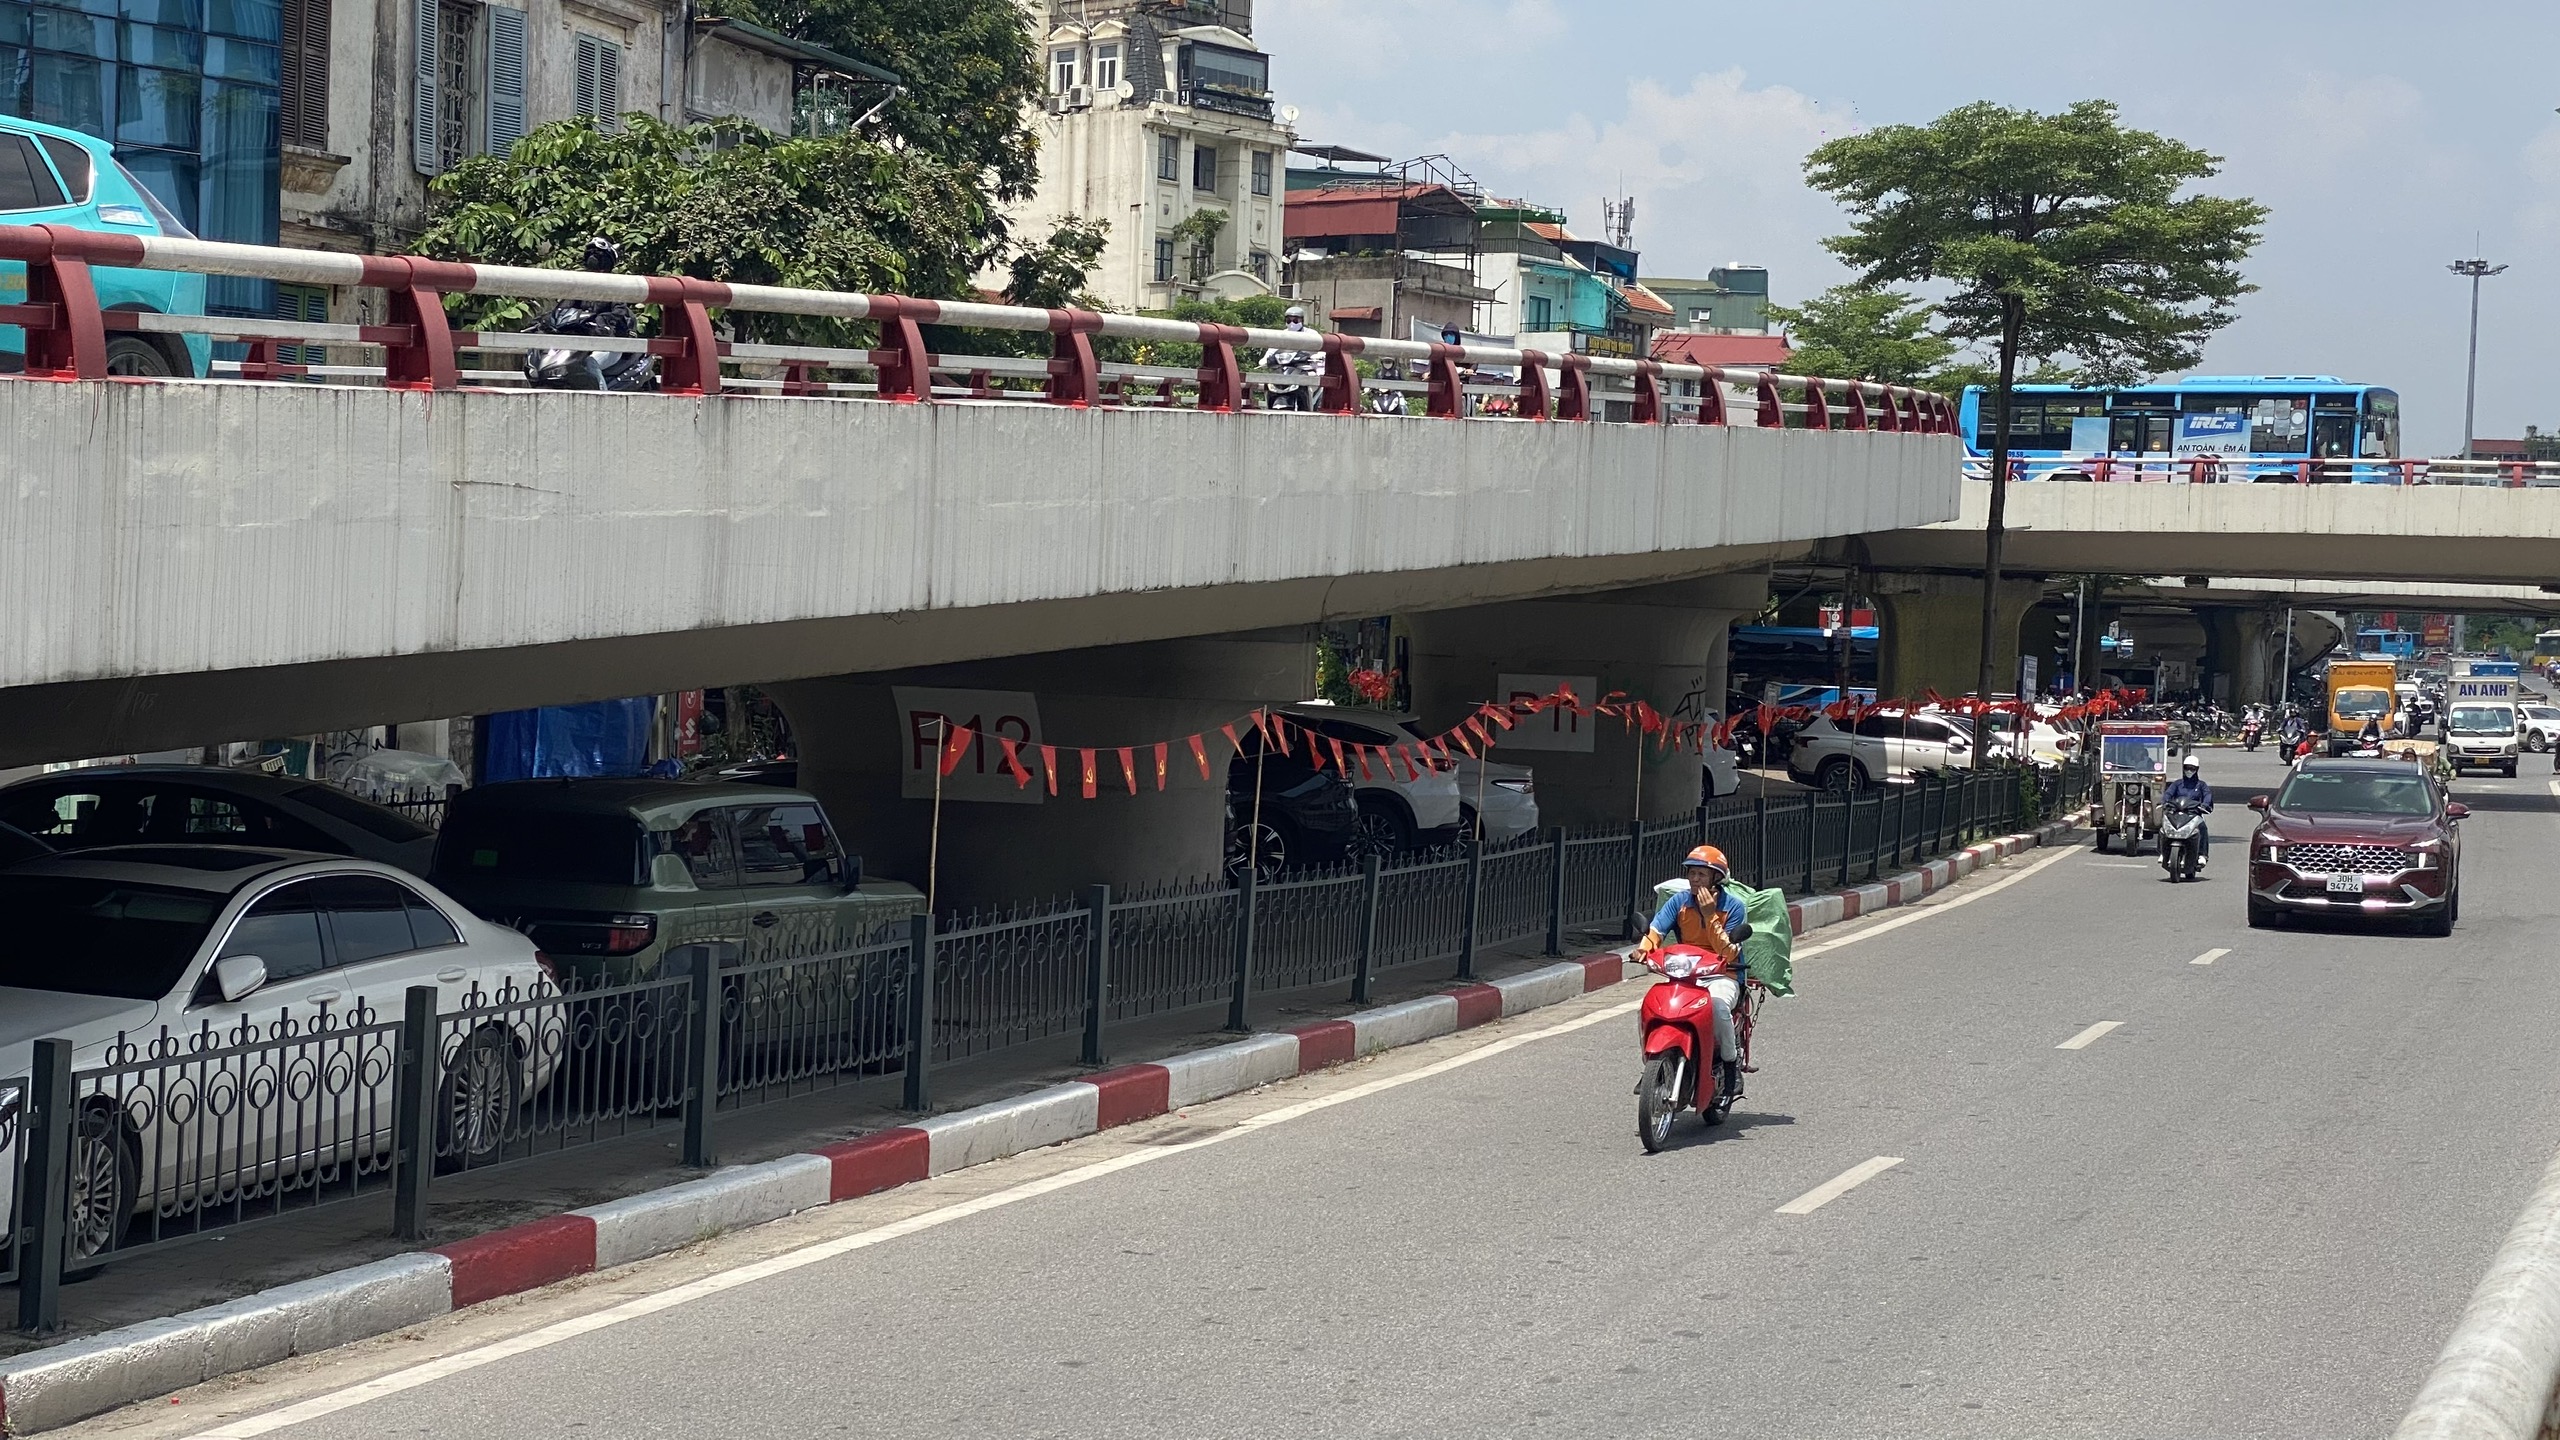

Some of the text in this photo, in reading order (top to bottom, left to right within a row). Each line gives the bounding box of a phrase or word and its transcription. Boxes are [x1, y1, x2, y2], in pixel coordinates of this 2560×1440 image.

[2192, 444, 2215, 452] TOÀN
[2223, 444, 2236, 452] ÊM
[2459, 684, 2507, 696] AN ANH
[909, 710, 1034, 777] P12
[2337, 875, 2353, 883] 30H
[2330, 882, 2359, 891] 947.24
